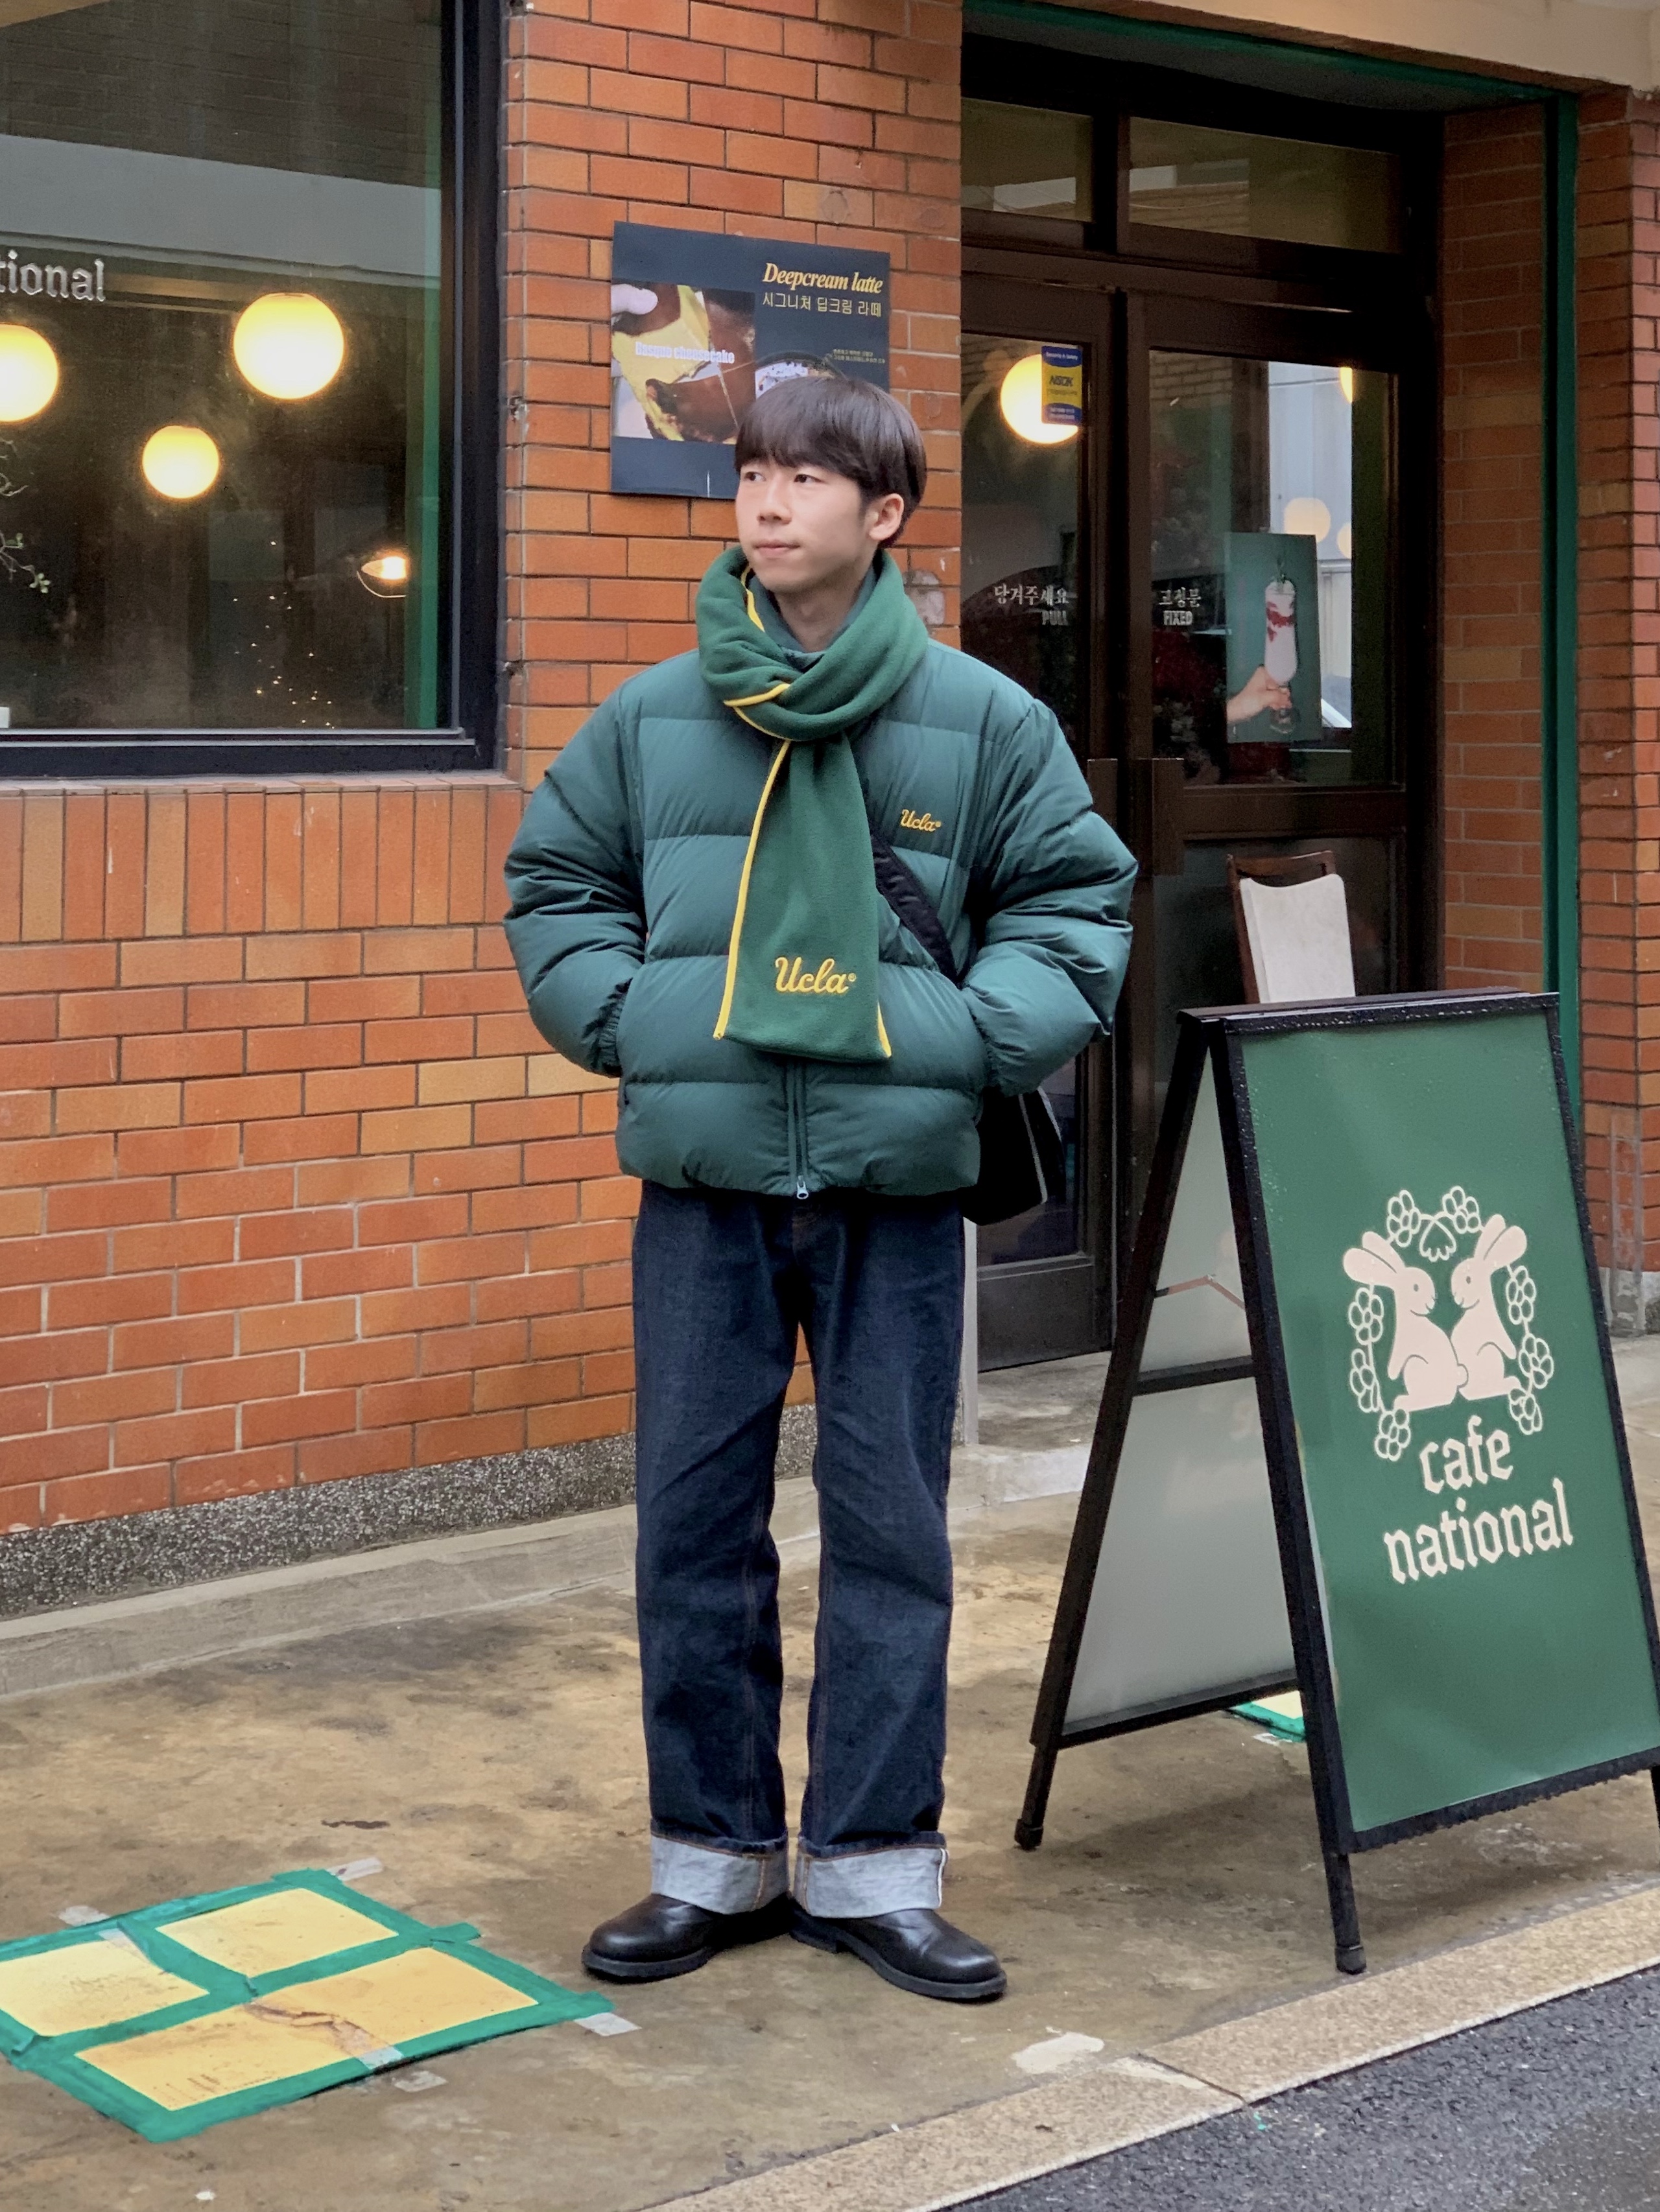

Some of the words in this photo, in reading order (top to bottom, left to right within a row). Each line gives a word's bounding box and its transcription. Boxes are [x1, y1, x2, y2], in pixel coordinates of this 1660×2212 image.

[763, 263, 849, 290] Deepcream
[851, 272, 883, 294] latte
[763, 292, 811, 311] 시그니처
[817, 297, 852, 314] 딥크림
[858, 301, 882, 318] 라떼
[993, 583, 1069, 607] 당겨주세요
[1159, 587, 1202, 608] 고정문
[1041, 609, 1069, 626] PULL
[1163, 610, 1193, 626] FIXED
[1419, 1415, 1514, 1494] cafe
[1383, 1477, 1574, 1584] national
